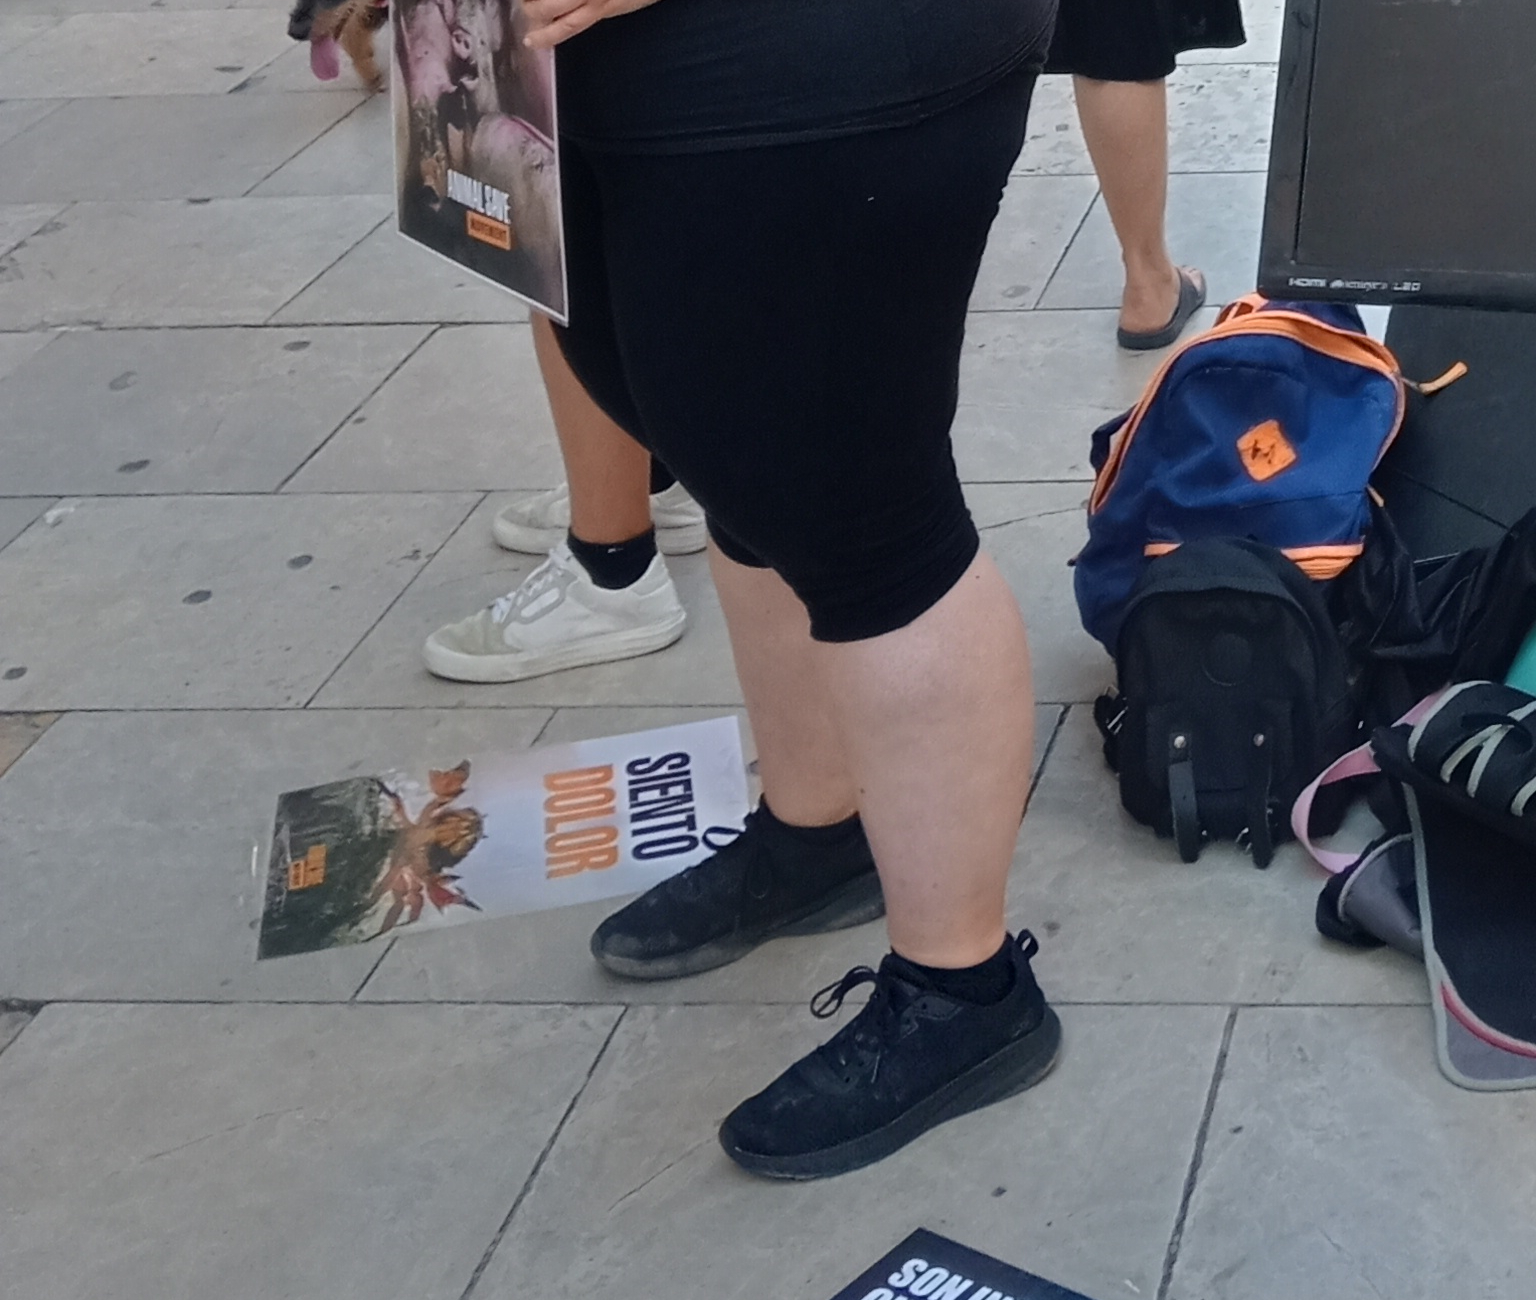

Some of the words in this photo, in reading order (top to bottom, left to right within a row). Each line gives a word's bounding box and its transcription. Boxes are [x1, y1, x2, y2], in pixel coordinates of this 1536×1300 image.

[543, 763, 619, 879] DOLOR
[625, 752, 699, 860] SIENTO
[887, 1258, 975, 1300] SON
